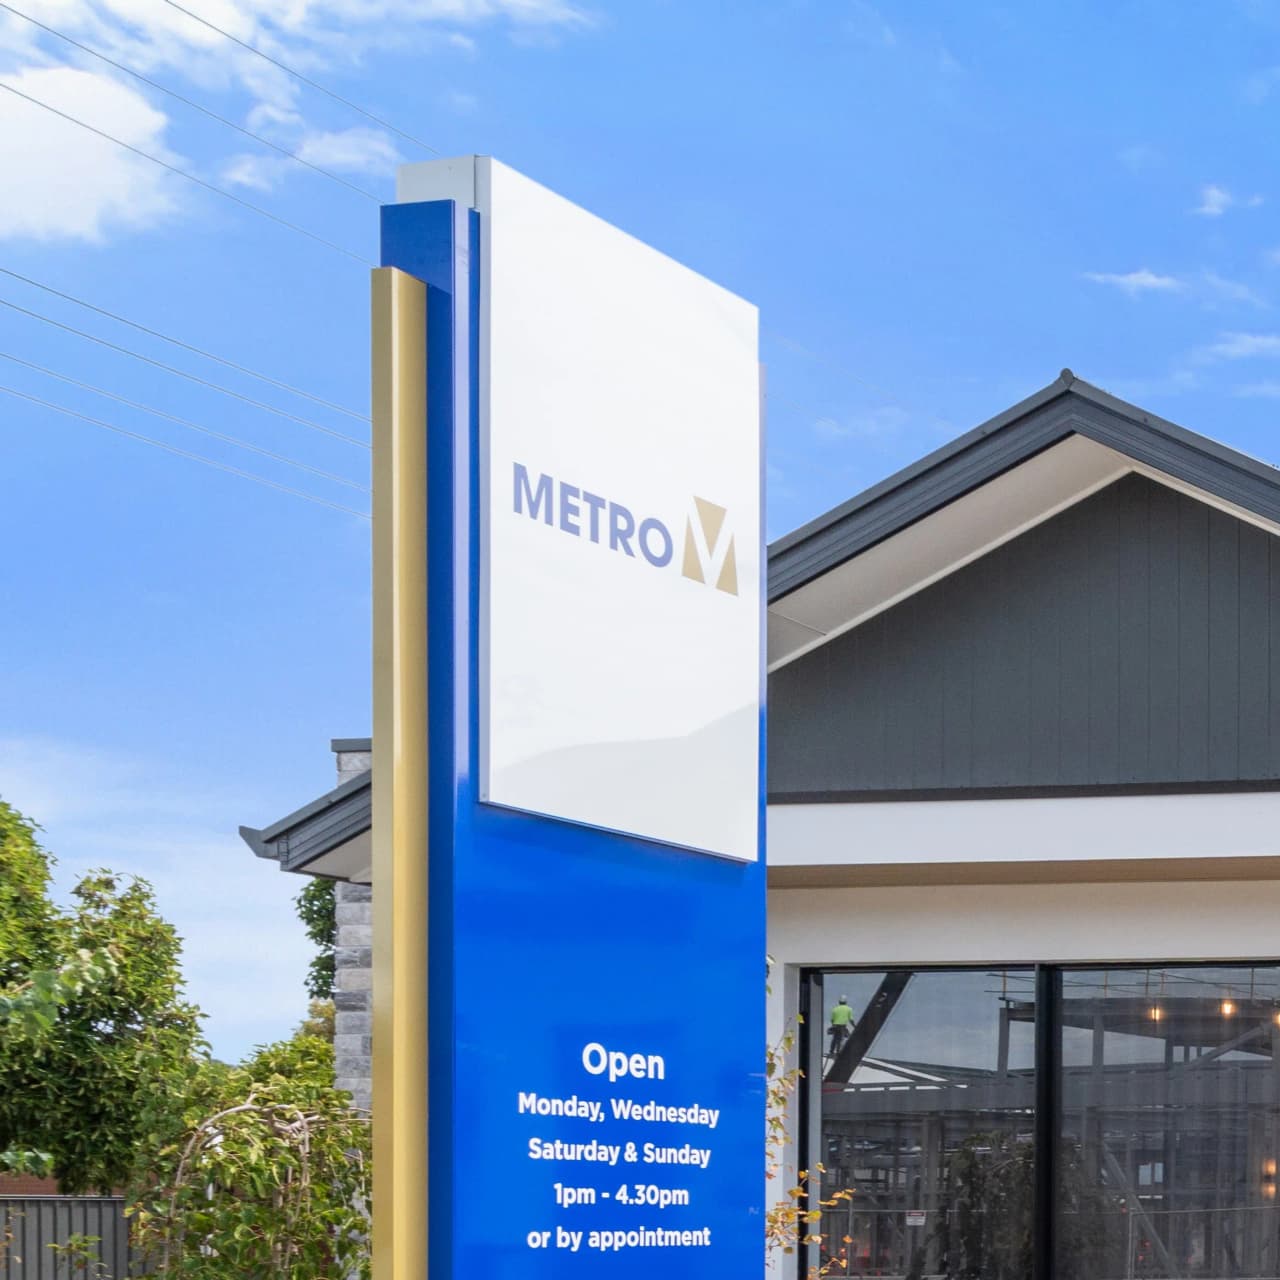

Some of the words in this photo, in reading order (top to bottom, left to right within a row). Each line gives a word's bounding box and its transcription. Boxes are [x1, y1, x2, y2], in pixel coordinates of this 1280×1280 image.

[513, 461, 673, 568] METRO
[582, 1042, 665, 1082] Open
[518, 1092, 605, 1122] Monday,
[610, 1098, 719, 1128] Wednesday
[528, 1138, 620, 1165] Saturday
[623, 1142, 638, 1162] &
[643, 1143, 711, 1168] Sunday
[553, 1183, 596, 1208] 1pm
[615, 1184, 689, 1208] 4.30pm
[527, 1232, 551, 1248] or
[556, 1226, 583, 1252] by
[588, 1226, 711, 1251] appointment
